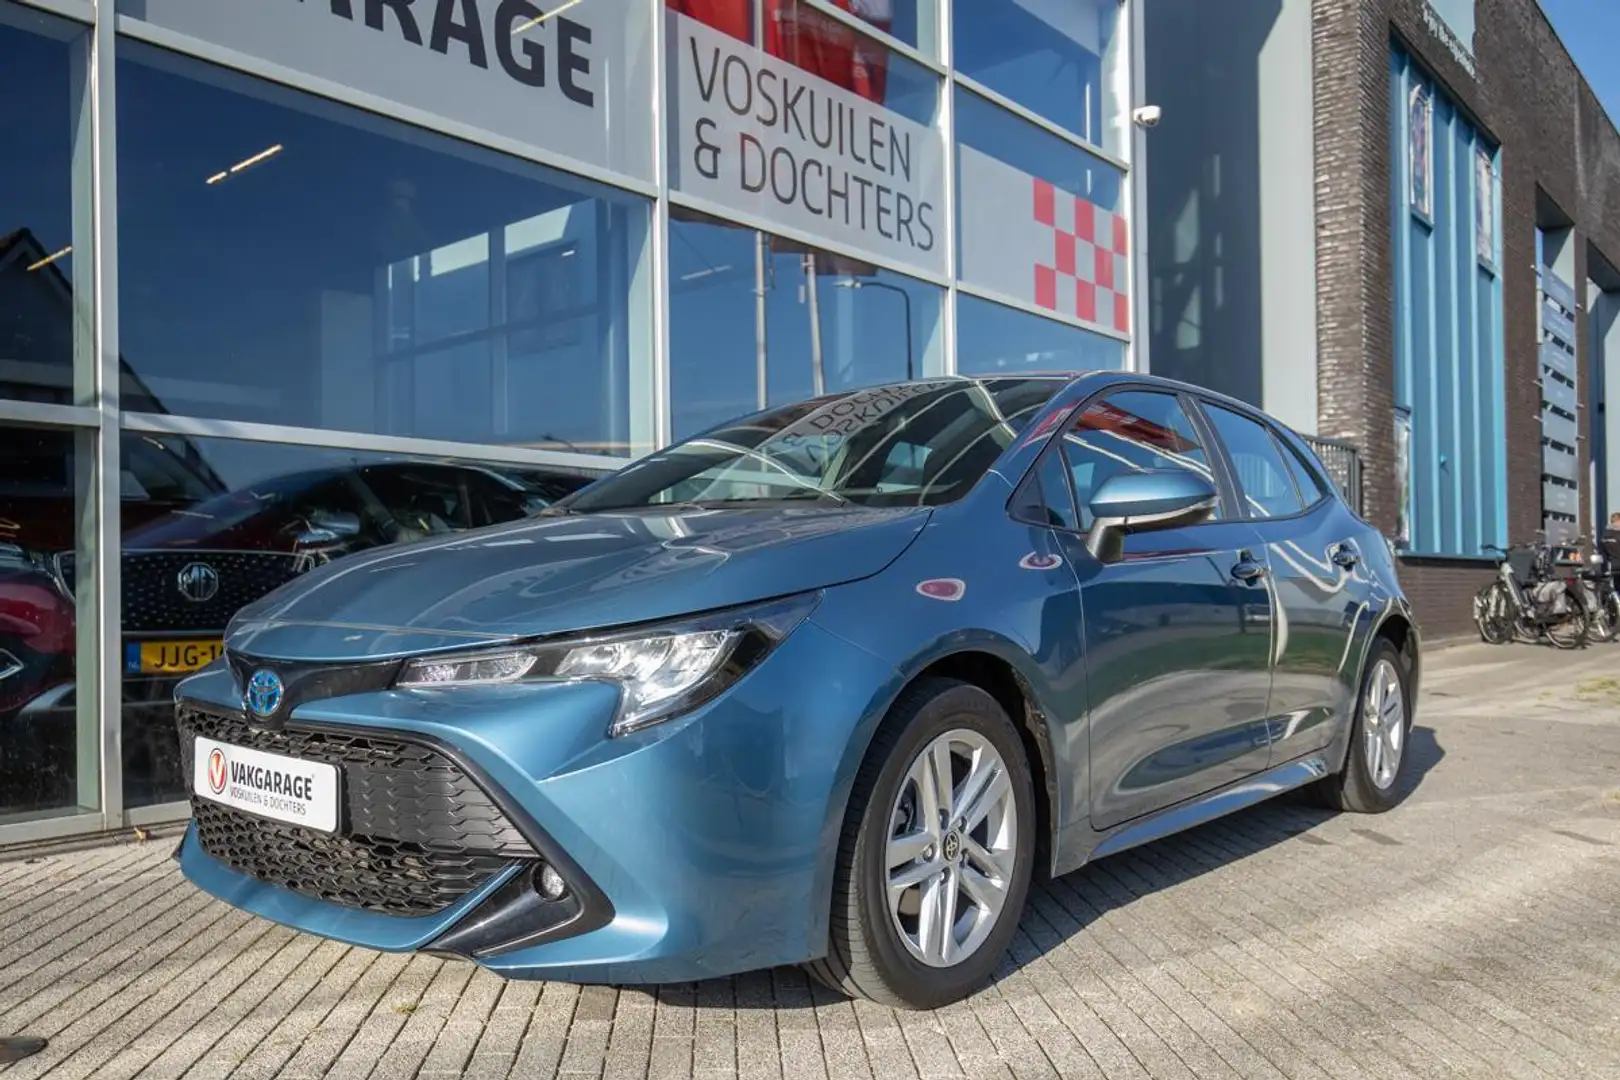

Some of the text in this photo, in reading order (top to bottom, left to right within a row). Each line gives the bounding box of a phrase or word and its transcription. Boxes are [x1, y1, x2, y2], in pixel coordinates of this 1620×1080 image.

[331, 0, 594, 108] AGE
[690, 36, 910, 182] VOSKUILEN
[694, 118, 933, 251] & DOCHTERS
[154, 645, 224, 668] JJG-1
[230, 786, 306, 815] VOSKUILEN & DOCHTERS
[231, 760, 313, 800] VAKGARAGE
